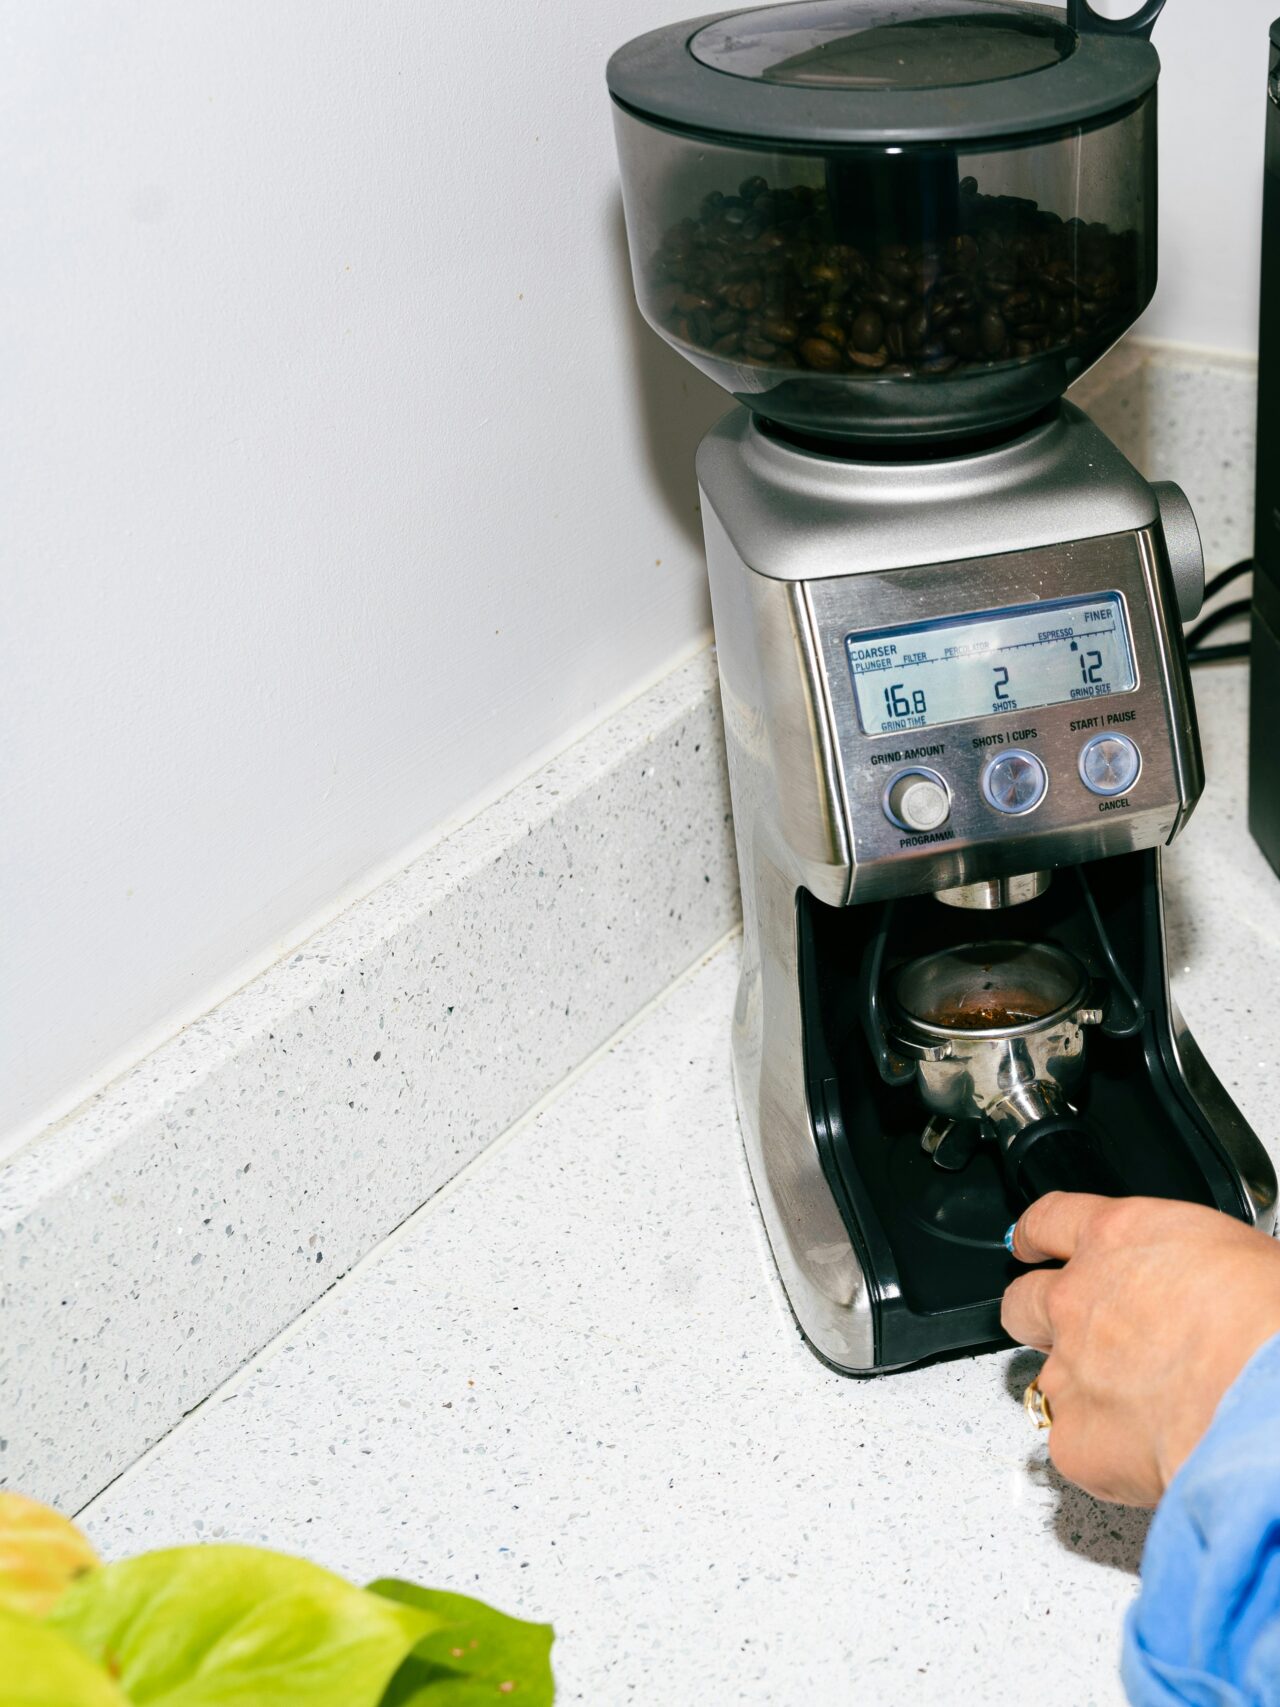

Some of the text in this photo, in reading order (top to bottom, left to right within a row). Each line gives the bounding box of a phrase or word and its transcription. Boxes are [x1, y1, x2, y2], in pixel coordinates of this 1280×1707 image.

[1084, 608, 1113, 623] FINER
[1038, 627, 1074, 640] ESPRESSO
[851, 644, 897, 661] COARSER
[903, 652, 927, 663] FILTER
[855, 658, 892, 672] PLUNGER
[1080, 650, 1103, 684] 12
[993, 666, 1010, 699] 2
[1070, 682, 1112, 698] GRIND SIZE
[884, 683, 927, 718] 16.8
[992, 700, 1017, 712] SHOTS
[881, 715, 927, 731] GRIND TIME
[1070, 719, 1099, 732] START
[1107, 711, 1137, 725] PAUSE
[972, 734, 1004, 748] SHOTS
[1012, 728, 1038, 742] CUPS
[870, 744, 946, 766] GRIND AMOUNT
[1098, 799, 1130, 812] CANCEL
